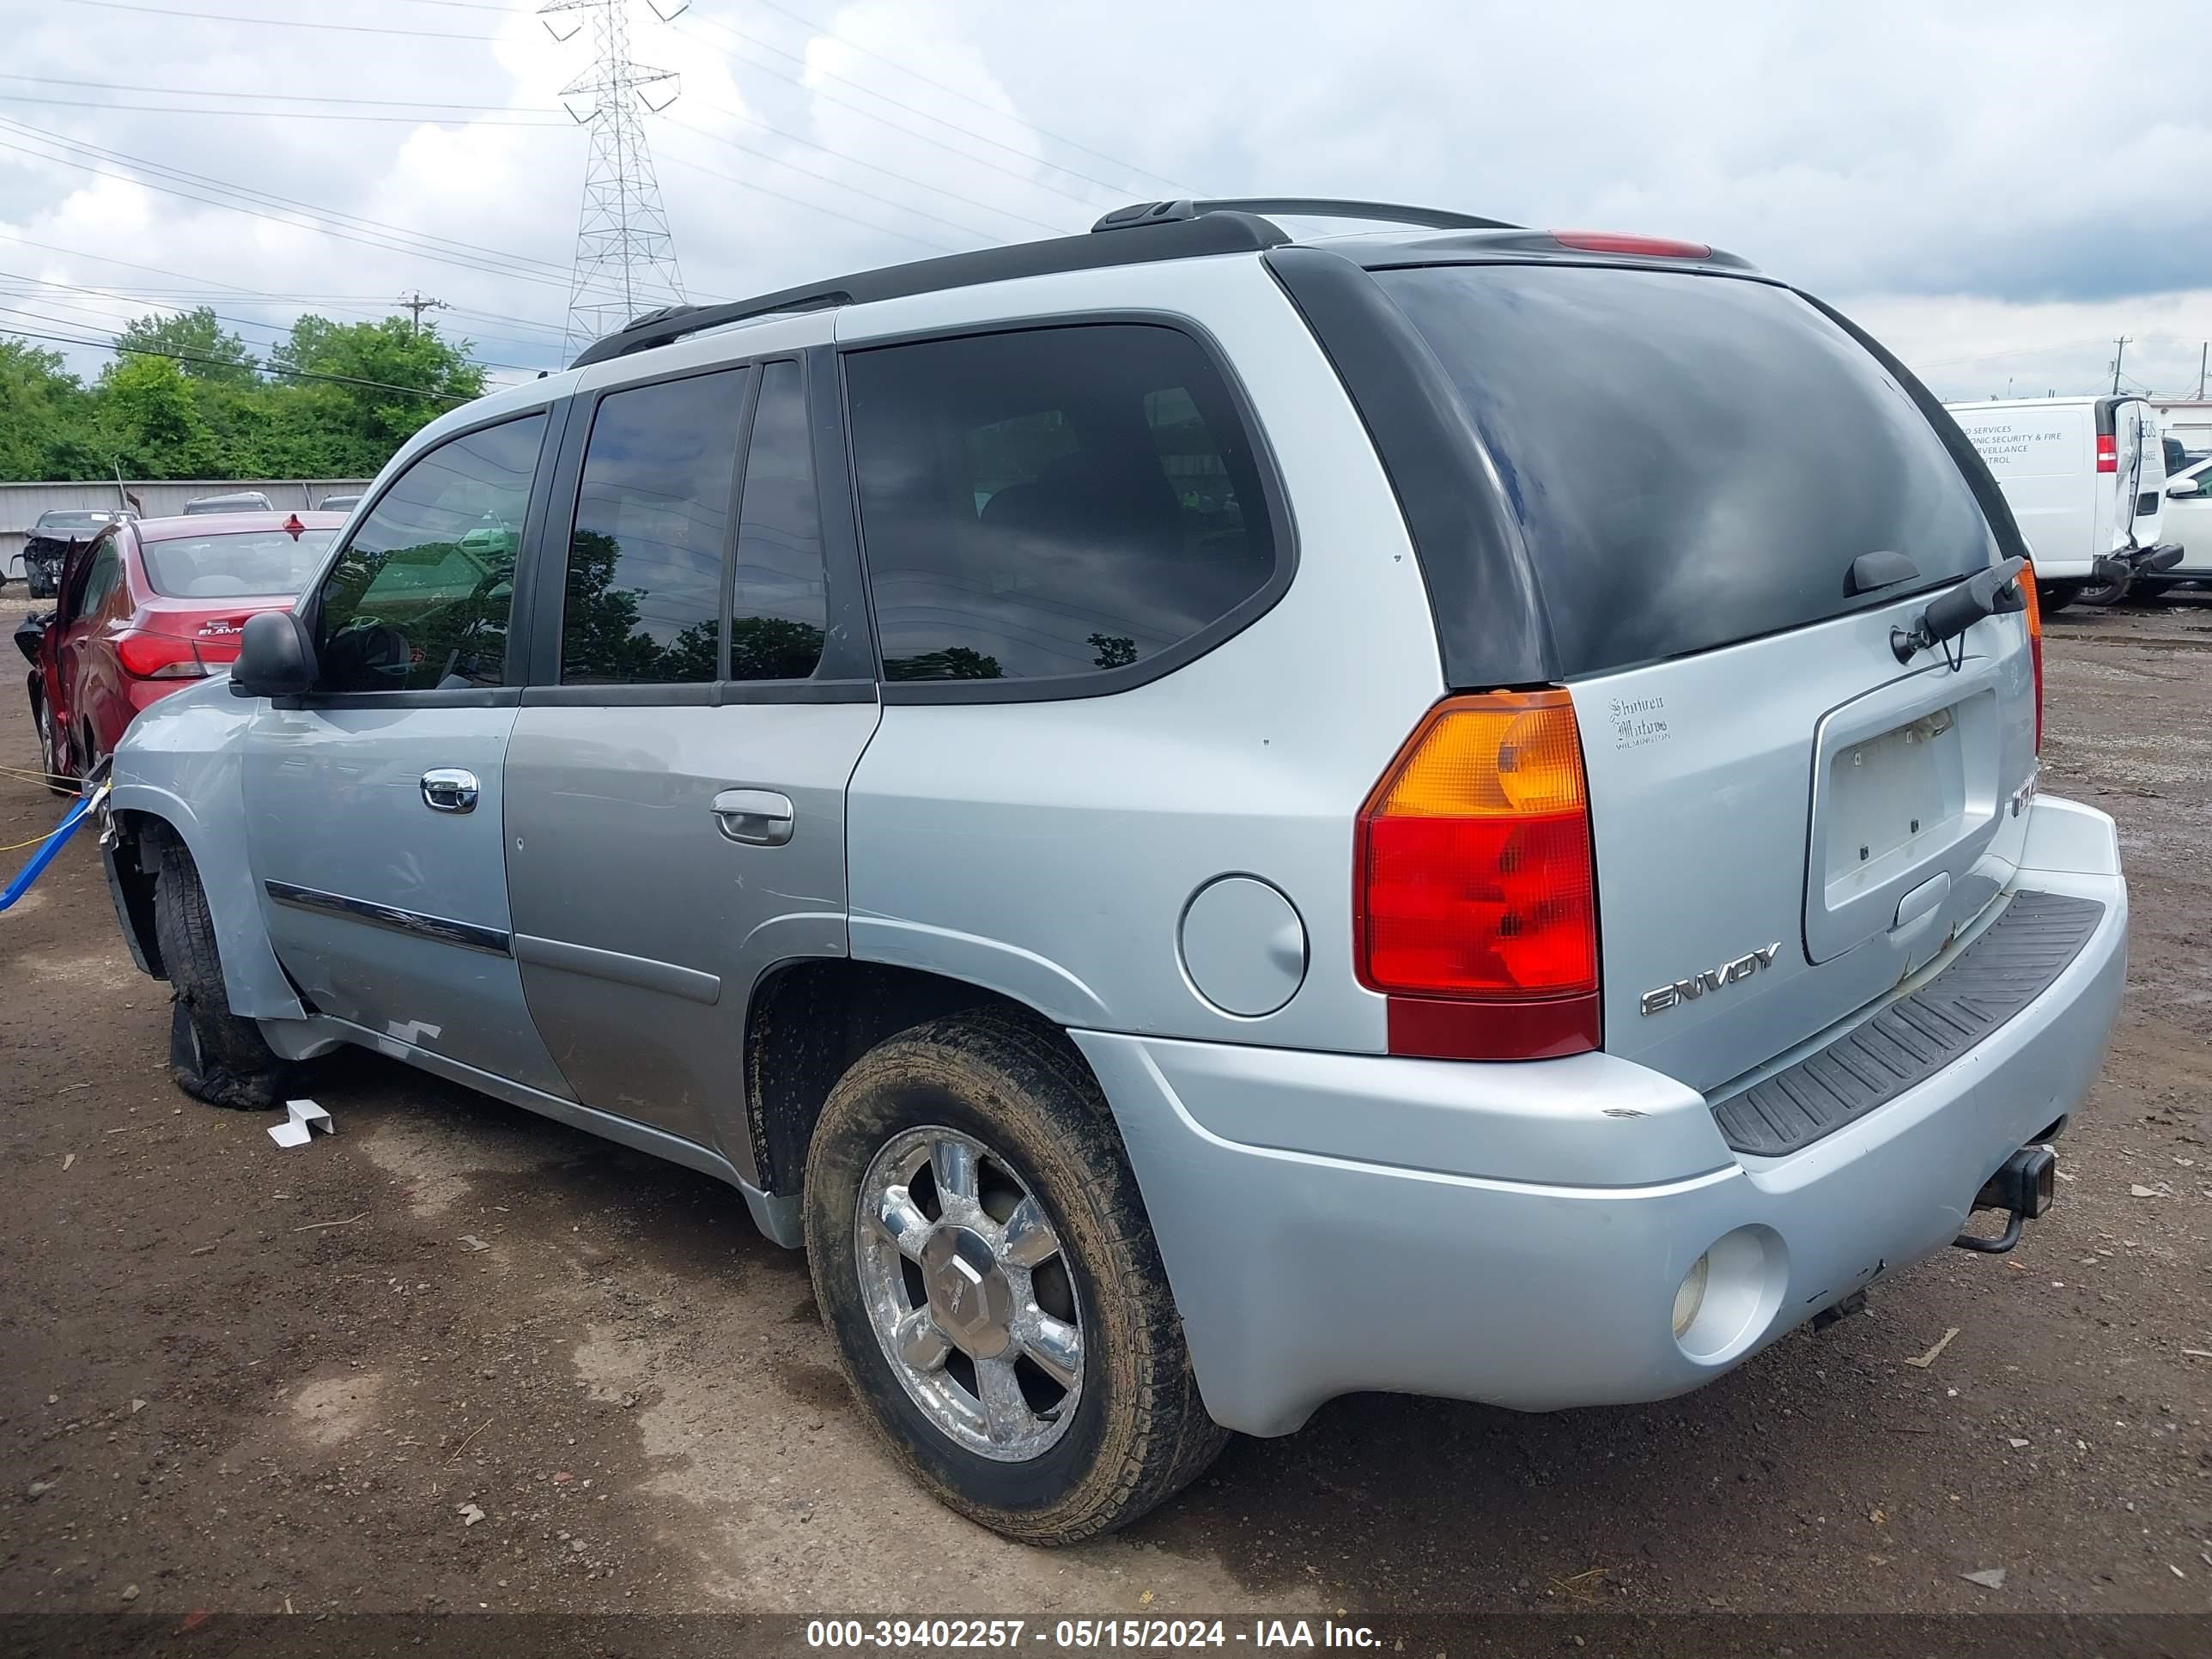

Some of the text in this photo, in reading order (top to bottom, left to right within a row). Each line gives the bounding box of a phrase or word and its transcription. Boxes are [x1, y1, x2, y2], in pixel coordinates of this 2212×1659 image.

[1973, 425, 2012, 434] SERVICES
[1991, 434, 2033, 443] SECURITY
[2044, 432, 2062, 441] FIRE
[1615, 732, 1671, 750] WILMINGTON
[1640, 940, 1782, 1017] ENVOY
